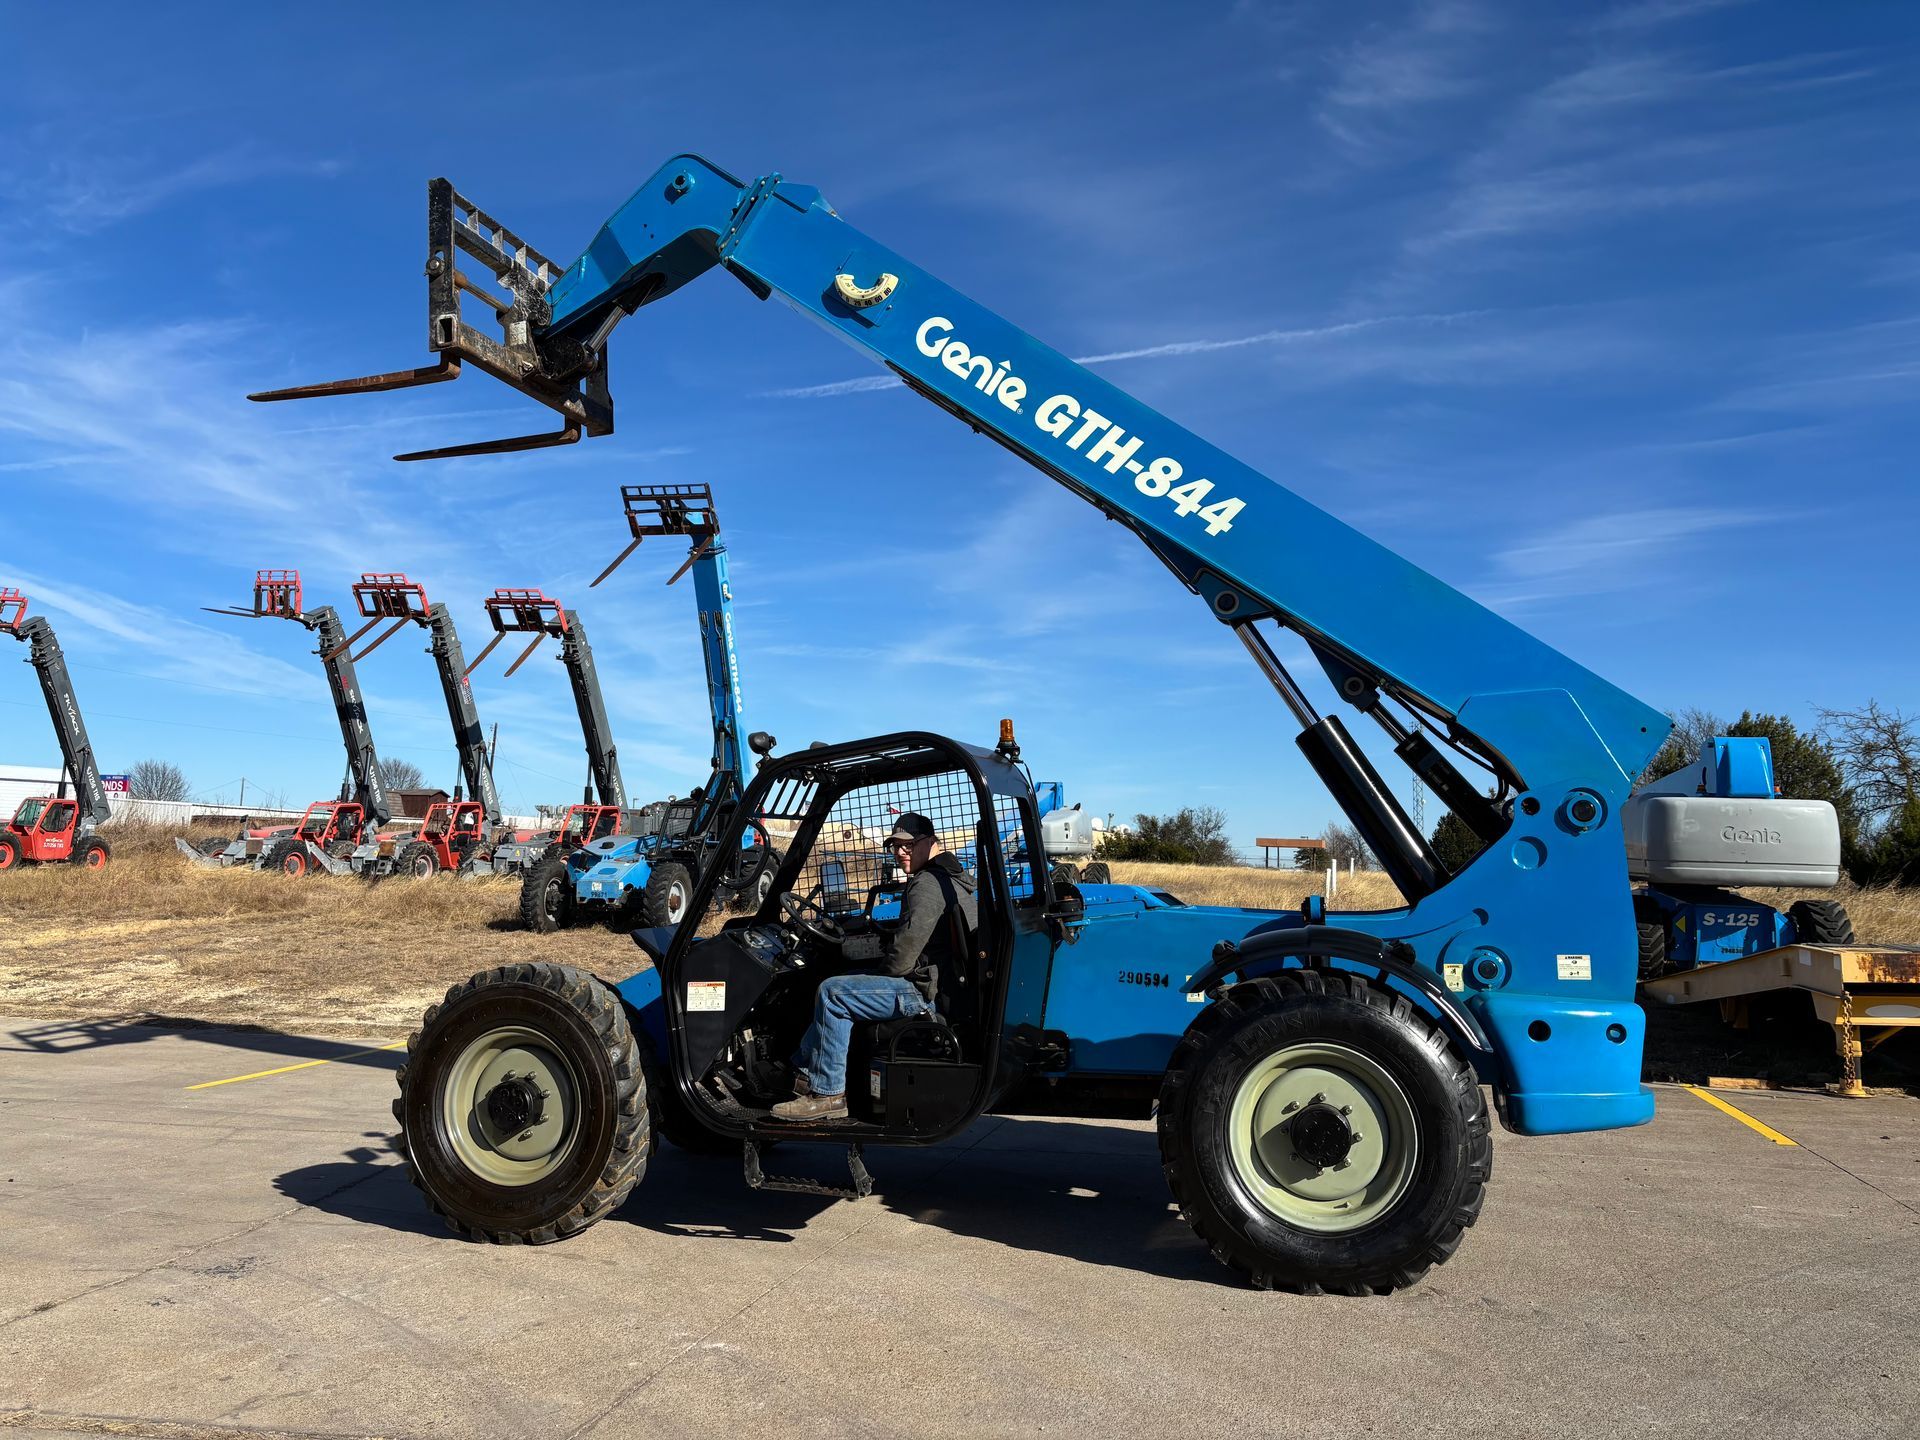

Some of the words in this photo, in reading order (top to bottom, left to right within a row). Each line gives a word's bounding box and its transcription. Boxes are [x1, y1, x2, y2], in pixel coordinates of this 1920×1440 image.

[915, 316, 1027, 413] Genie
[1034, 394, 1247, 536] GTH-844
[725, 612, 734, 651] Genie
[730, 653, 743, 714] GTH-844
[63, 692, 81, 736] SKYJACK
[1720, 825, 1782, 844] Genie
[1118, 970, 1169, 988] 290594
